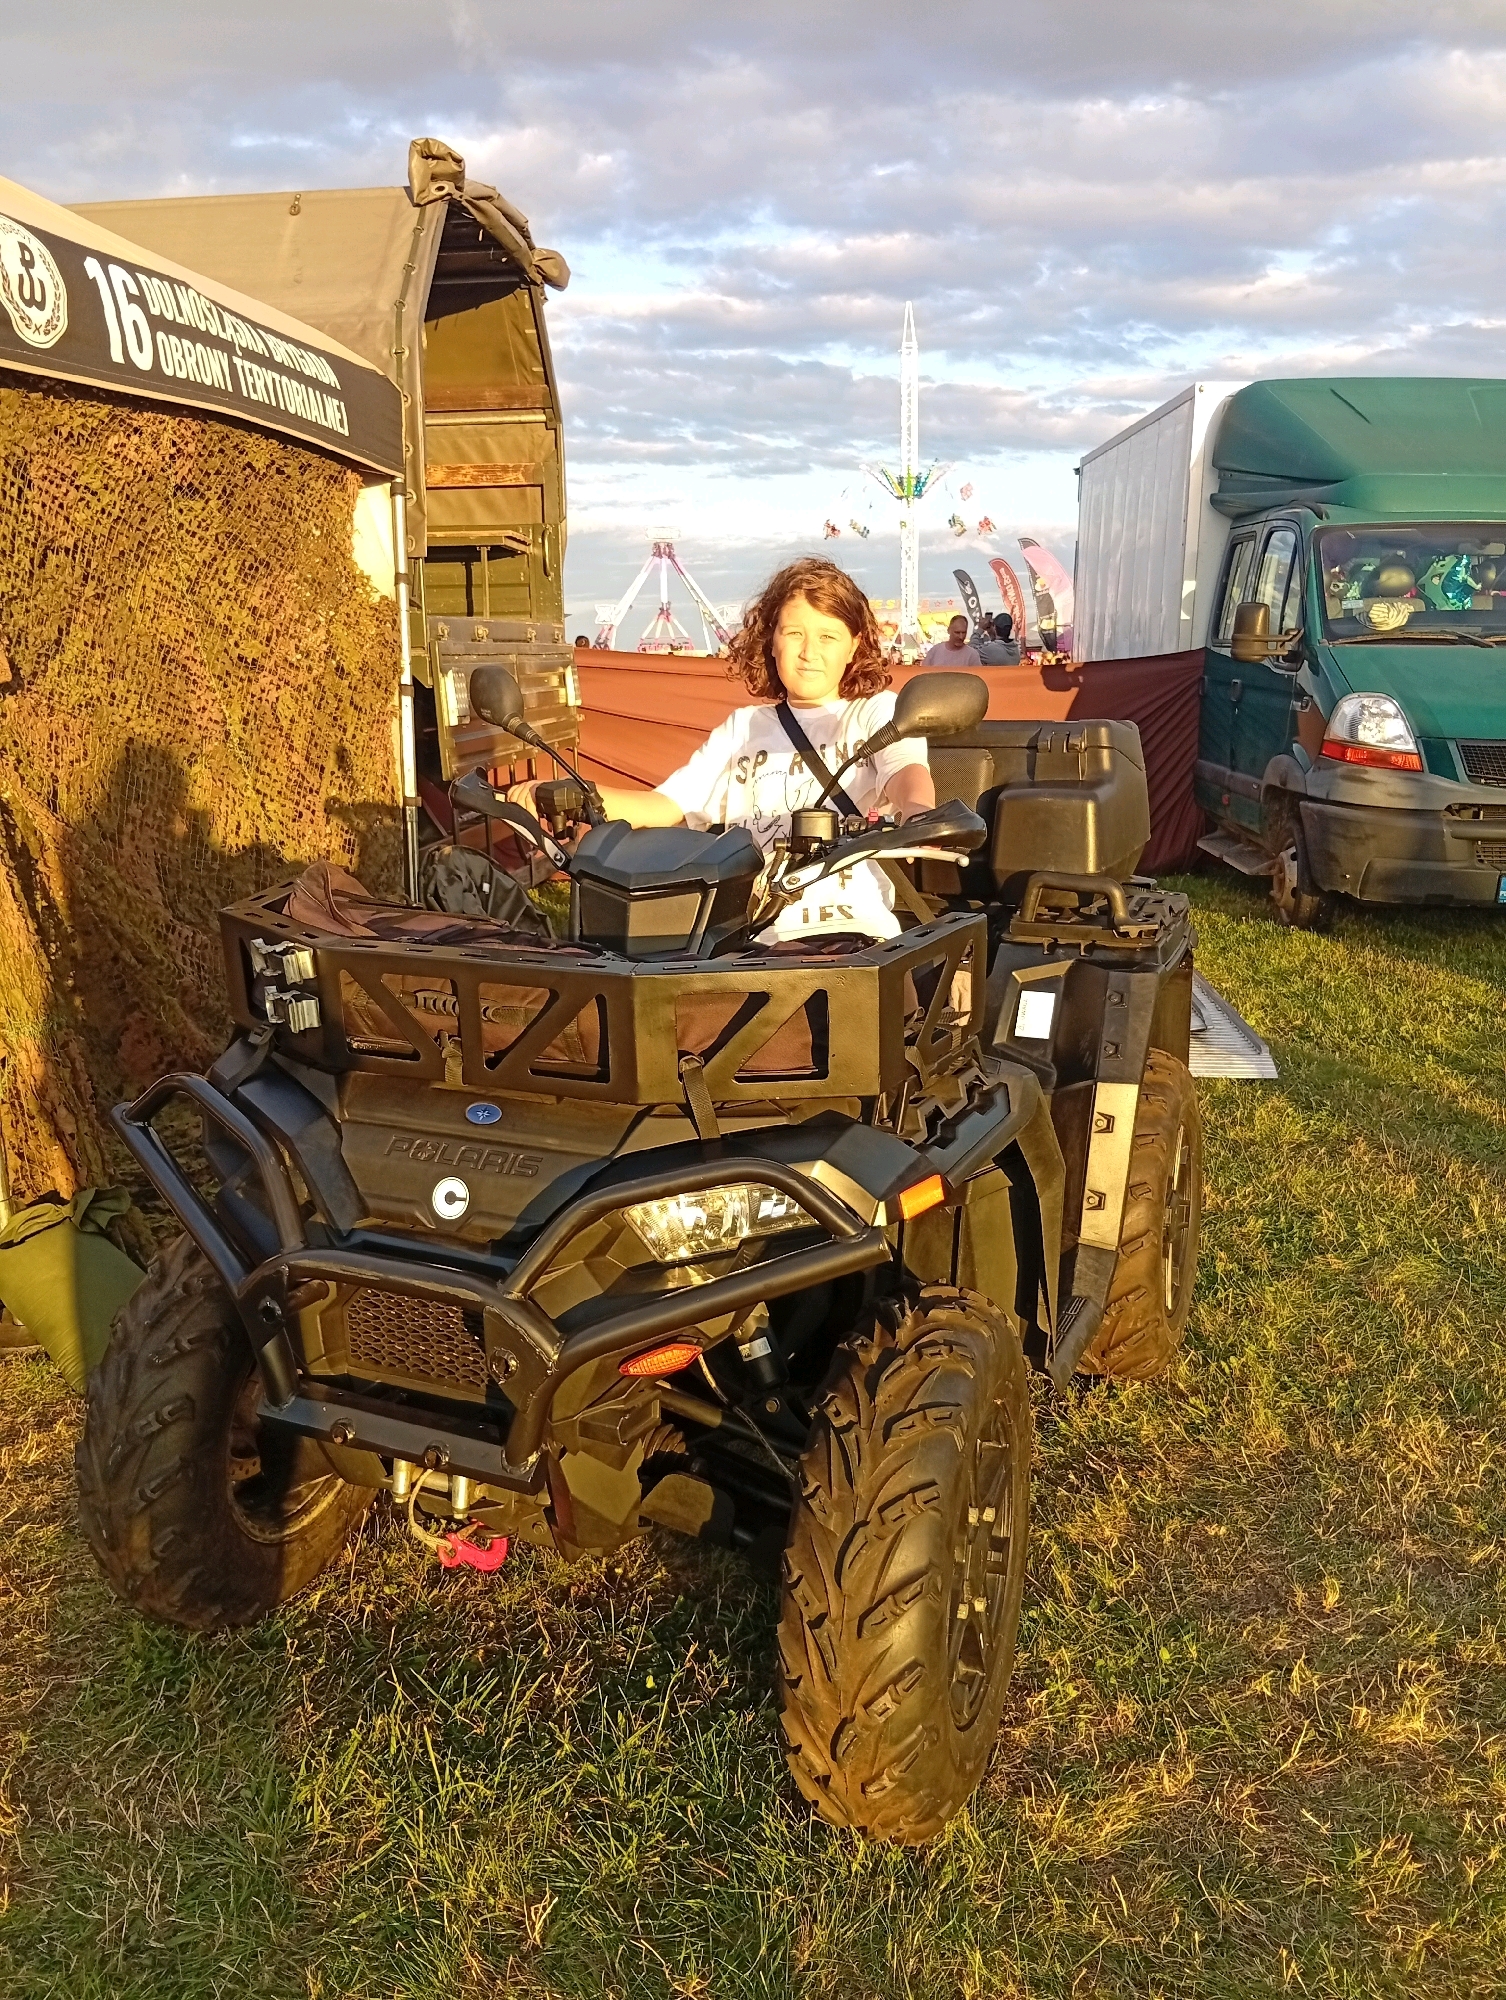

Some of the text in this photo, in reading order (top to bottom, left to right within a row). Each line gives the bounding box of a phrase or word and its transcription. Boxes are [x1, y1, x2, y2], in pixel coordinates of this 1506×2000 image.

[83, 256, 154, 371] 16
[256, 328, 342, 391] BRYGADA
[156, 331, 350, 437] OBRONY TERYTORIALNEJ
[384, 1135, 543, 1178] POLARIS
